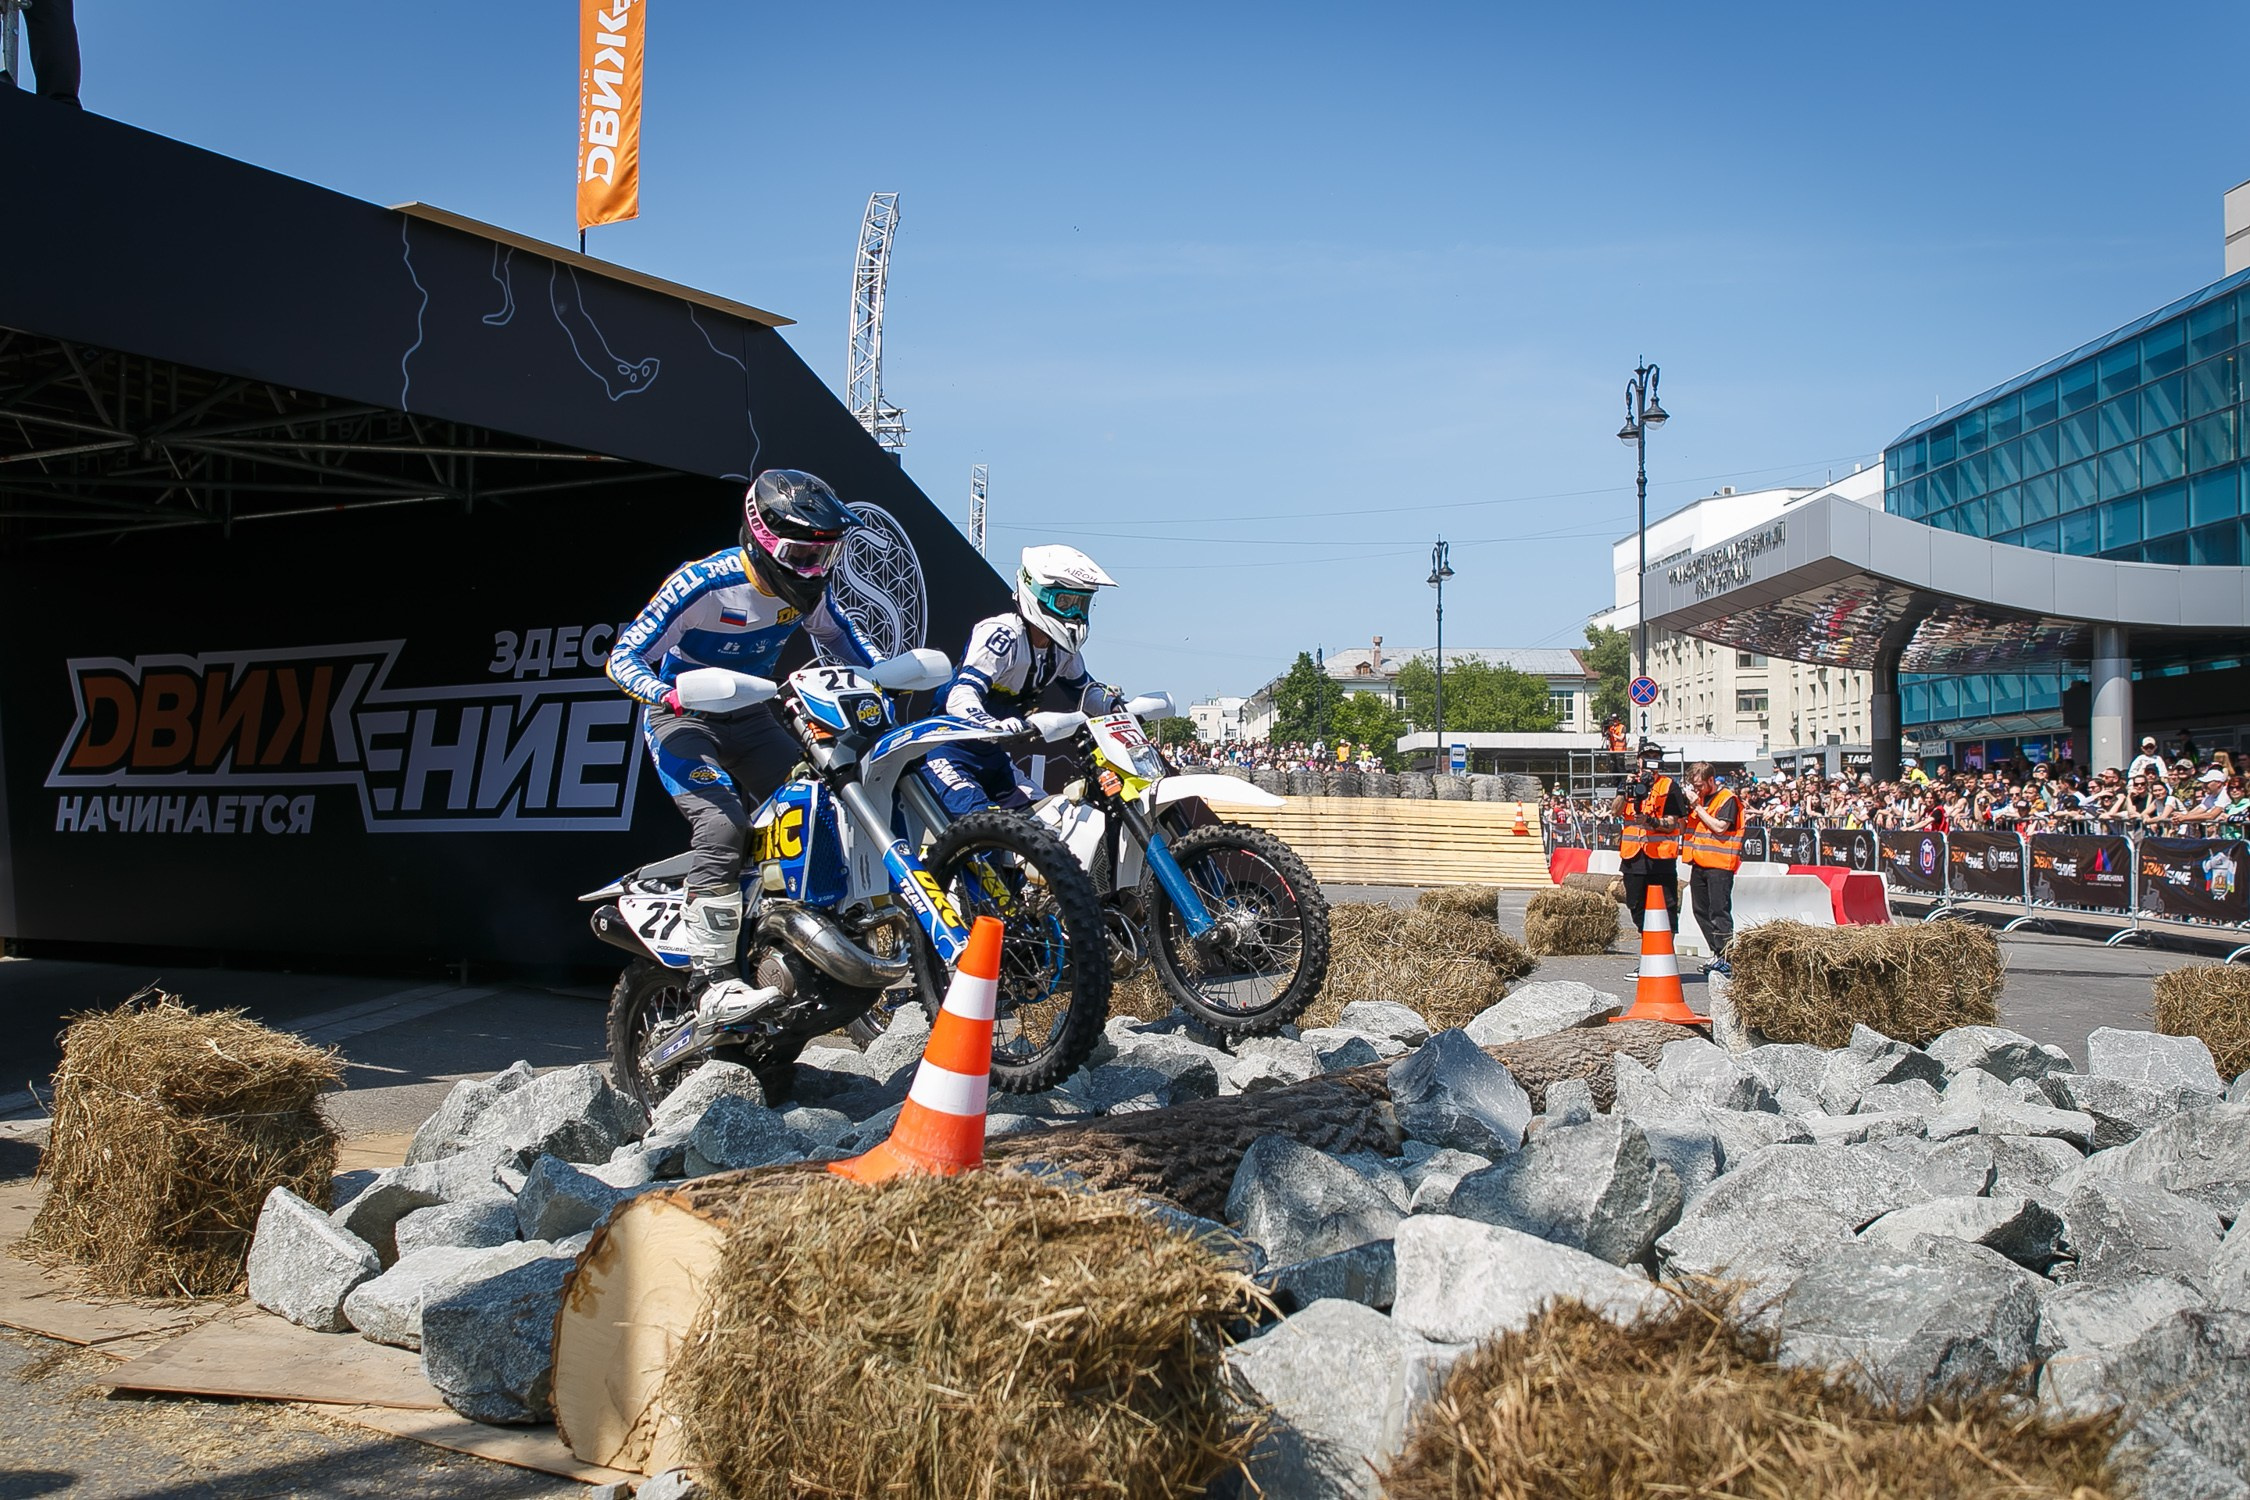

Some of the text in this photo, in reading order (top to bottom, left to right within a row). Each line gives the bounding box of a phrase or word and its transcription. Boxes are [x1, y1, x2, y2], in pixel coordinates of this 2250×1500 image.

[577, 68, 590, 184] ФЕСТИВАЛЬ
[776, 605, 801, 625] DR
[819, 668, 858, 692] 27
[857, 703, 881, 722] DRC
[1847, 754, 1872, 764] ТАБА
[55, 794, 316, 833] НАЧИНАЕТСЯ
[752, 807, 804, 862] DRC
[899, 877, 929, 915] TEAM
[911, 870, 967, 929] DRC
[638, 901, 682, 941] 27
[661, 1034, 690, 1060] 300
